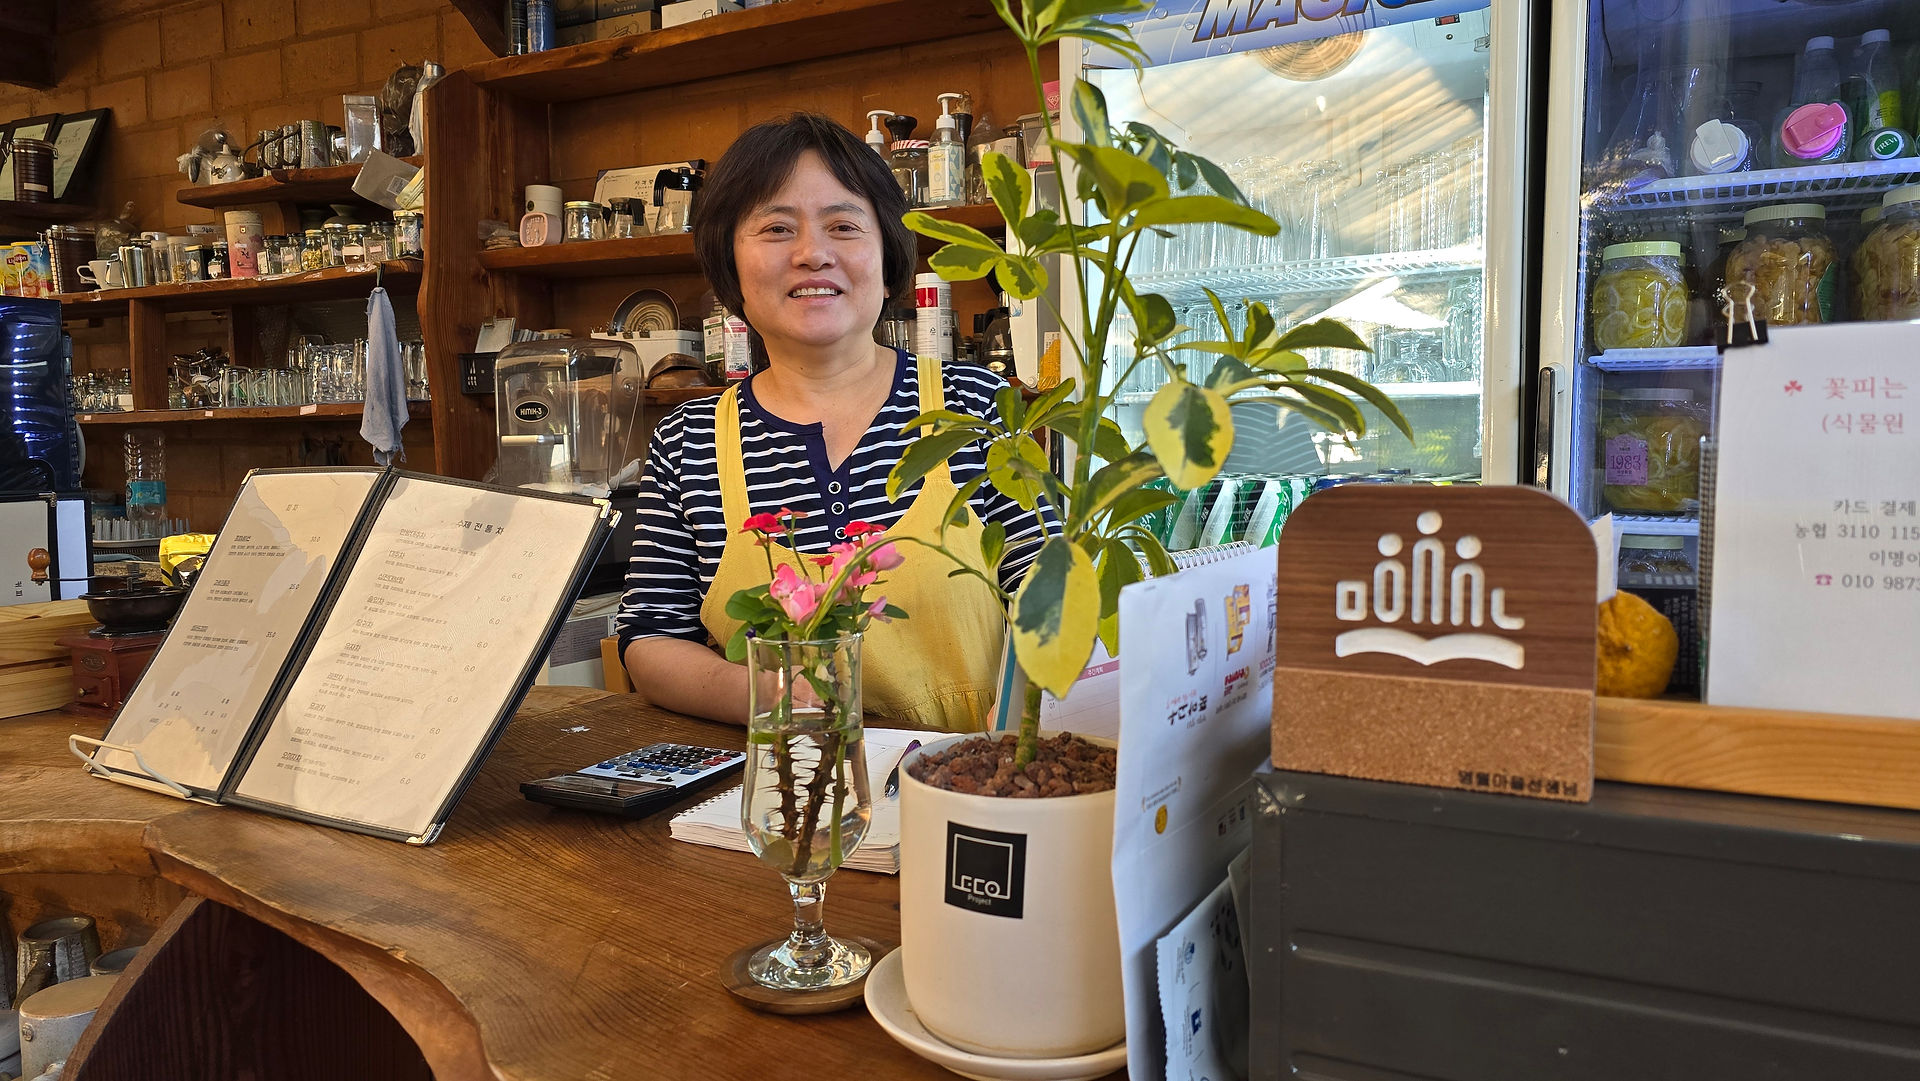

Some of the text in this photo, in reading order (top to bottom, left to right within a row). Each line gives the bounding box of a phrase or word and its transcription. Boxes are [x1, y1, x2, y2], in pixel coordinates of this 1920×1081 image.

[1876, 137, 1898, 153] TREVI
[1823, 376, 1908, 399] 꽃피는
[1821, 413, 1905, 434] (식물원
[1834, 500, 1917, 516] 카드 결제
[1795, 523, 1827, 539] 농협
[1838, 525, 1880, 539] 3110
[1841, 574, 1874, 589] 010
[961, 874, 1001, 898] ECO
[967, 893, 992, 906] Project
